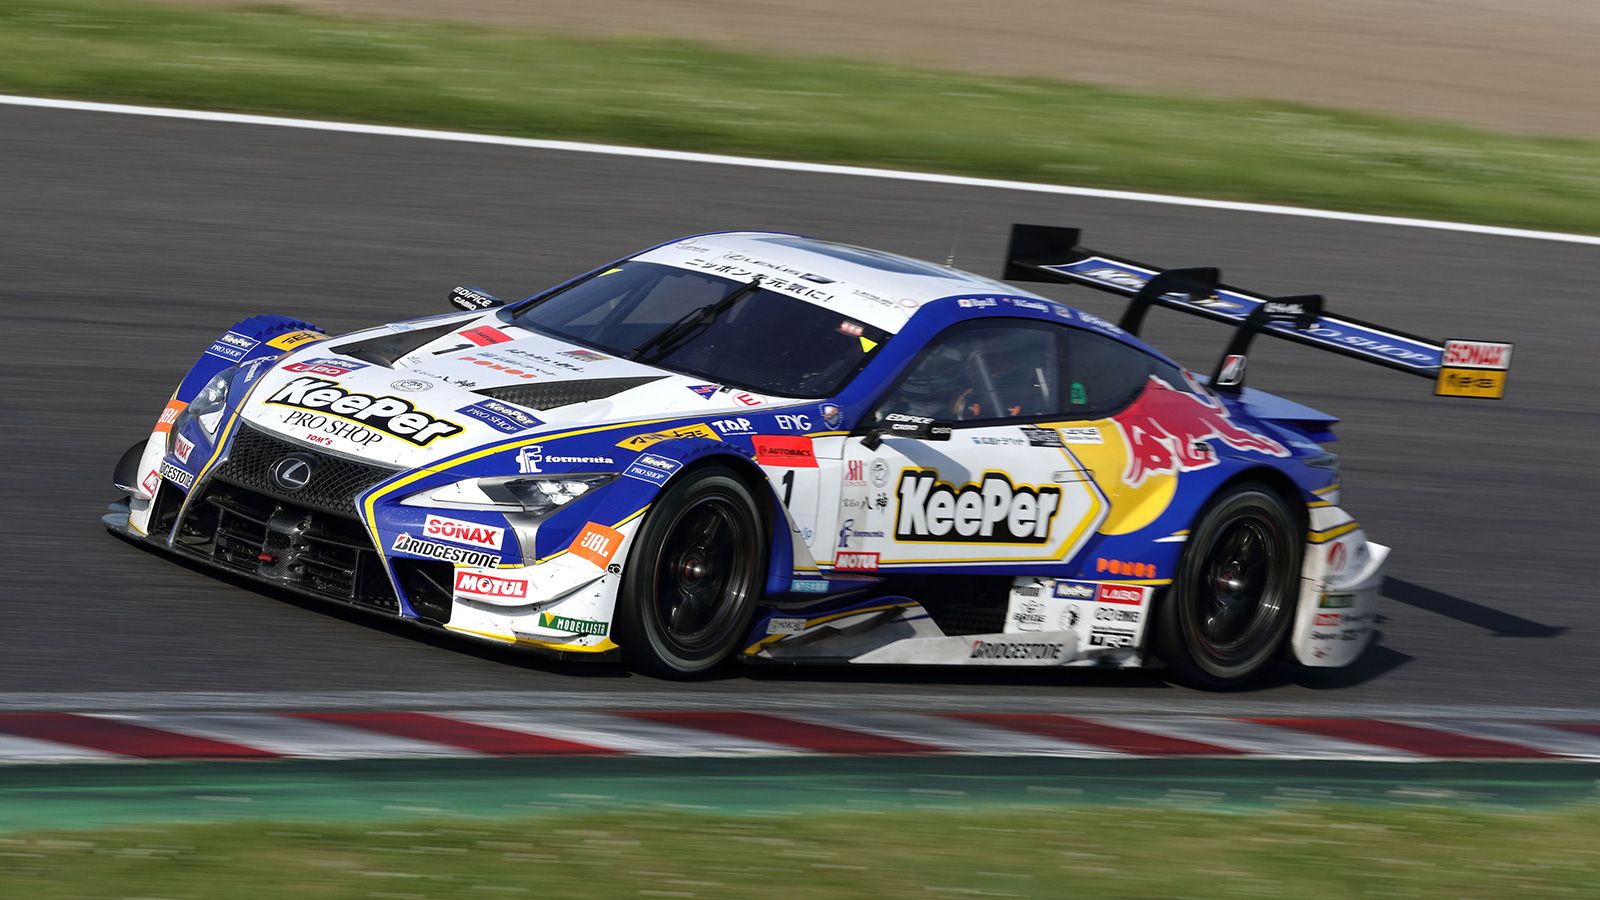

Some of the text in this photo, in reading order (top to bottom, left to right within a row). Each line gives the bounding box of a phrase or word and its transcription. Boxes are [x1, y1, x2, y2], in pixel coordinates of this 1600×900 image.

[453, 286, 493, 307] EDIFICE
[456, 356, 539, 379] PONOS
[266, 377, 463, 445] KeePer
[467, 408, 518, 432] PRO SHOP
[485, 401, 538, 426] KeePer
[283, 410, 383, 447] PRO SHOP
[306, 433, 333, 446] TOM'S
[545, 455, 614, 464] formenta
[641, 456, 676, 470] KeePer
[768, 447, 812, 457] AUTOBACS
[782, 470, 795, 511] 1
[896, 471, 1060, 542] KeePer
[427, 518, 497, 546] SONAX
[394, 535, 500, 568] BRIDGESTONE
[581, 530, 610, 559] JBL
[837, 554, 878, 569] MOTUL
[458, 574, 524, 597] MOTUL
[557, 618, 606, 635] MODELLISTA
[970, 640, 1064, 659] BRIDGESTONE
